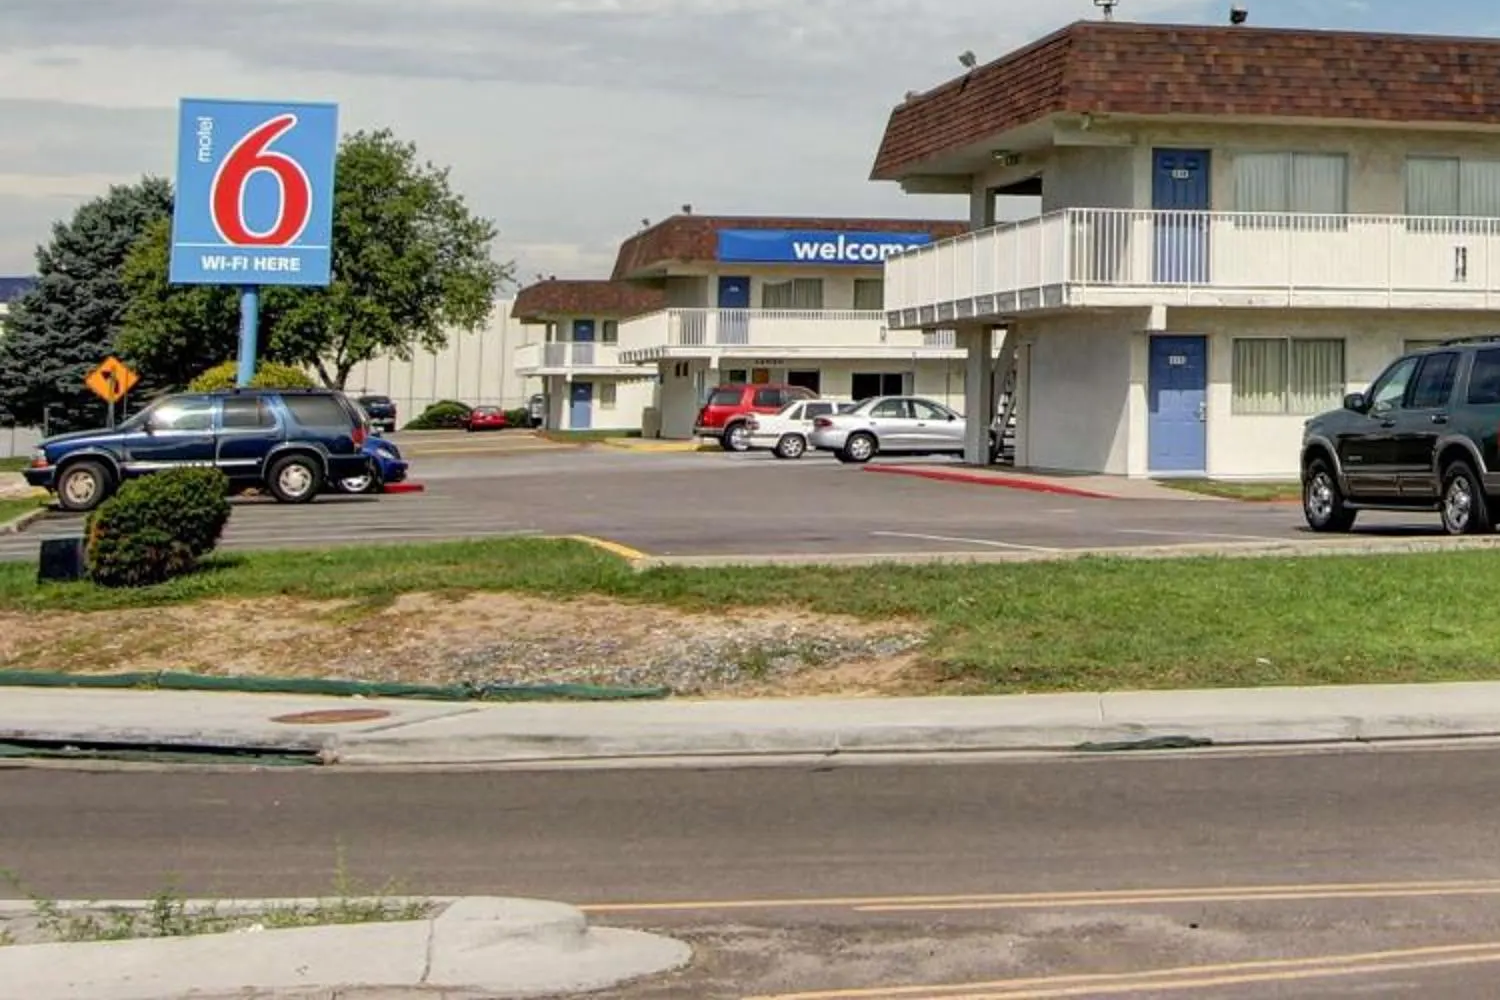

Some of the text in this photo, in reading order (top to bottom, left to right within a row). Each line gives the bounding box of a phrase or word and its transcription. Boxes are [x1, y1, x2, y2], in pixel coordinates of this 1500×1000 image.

[197, 116, 213, 163] motel
[210, 114, 312, 247] 6
[201, 255, 301, 271] WI-FI HERE
